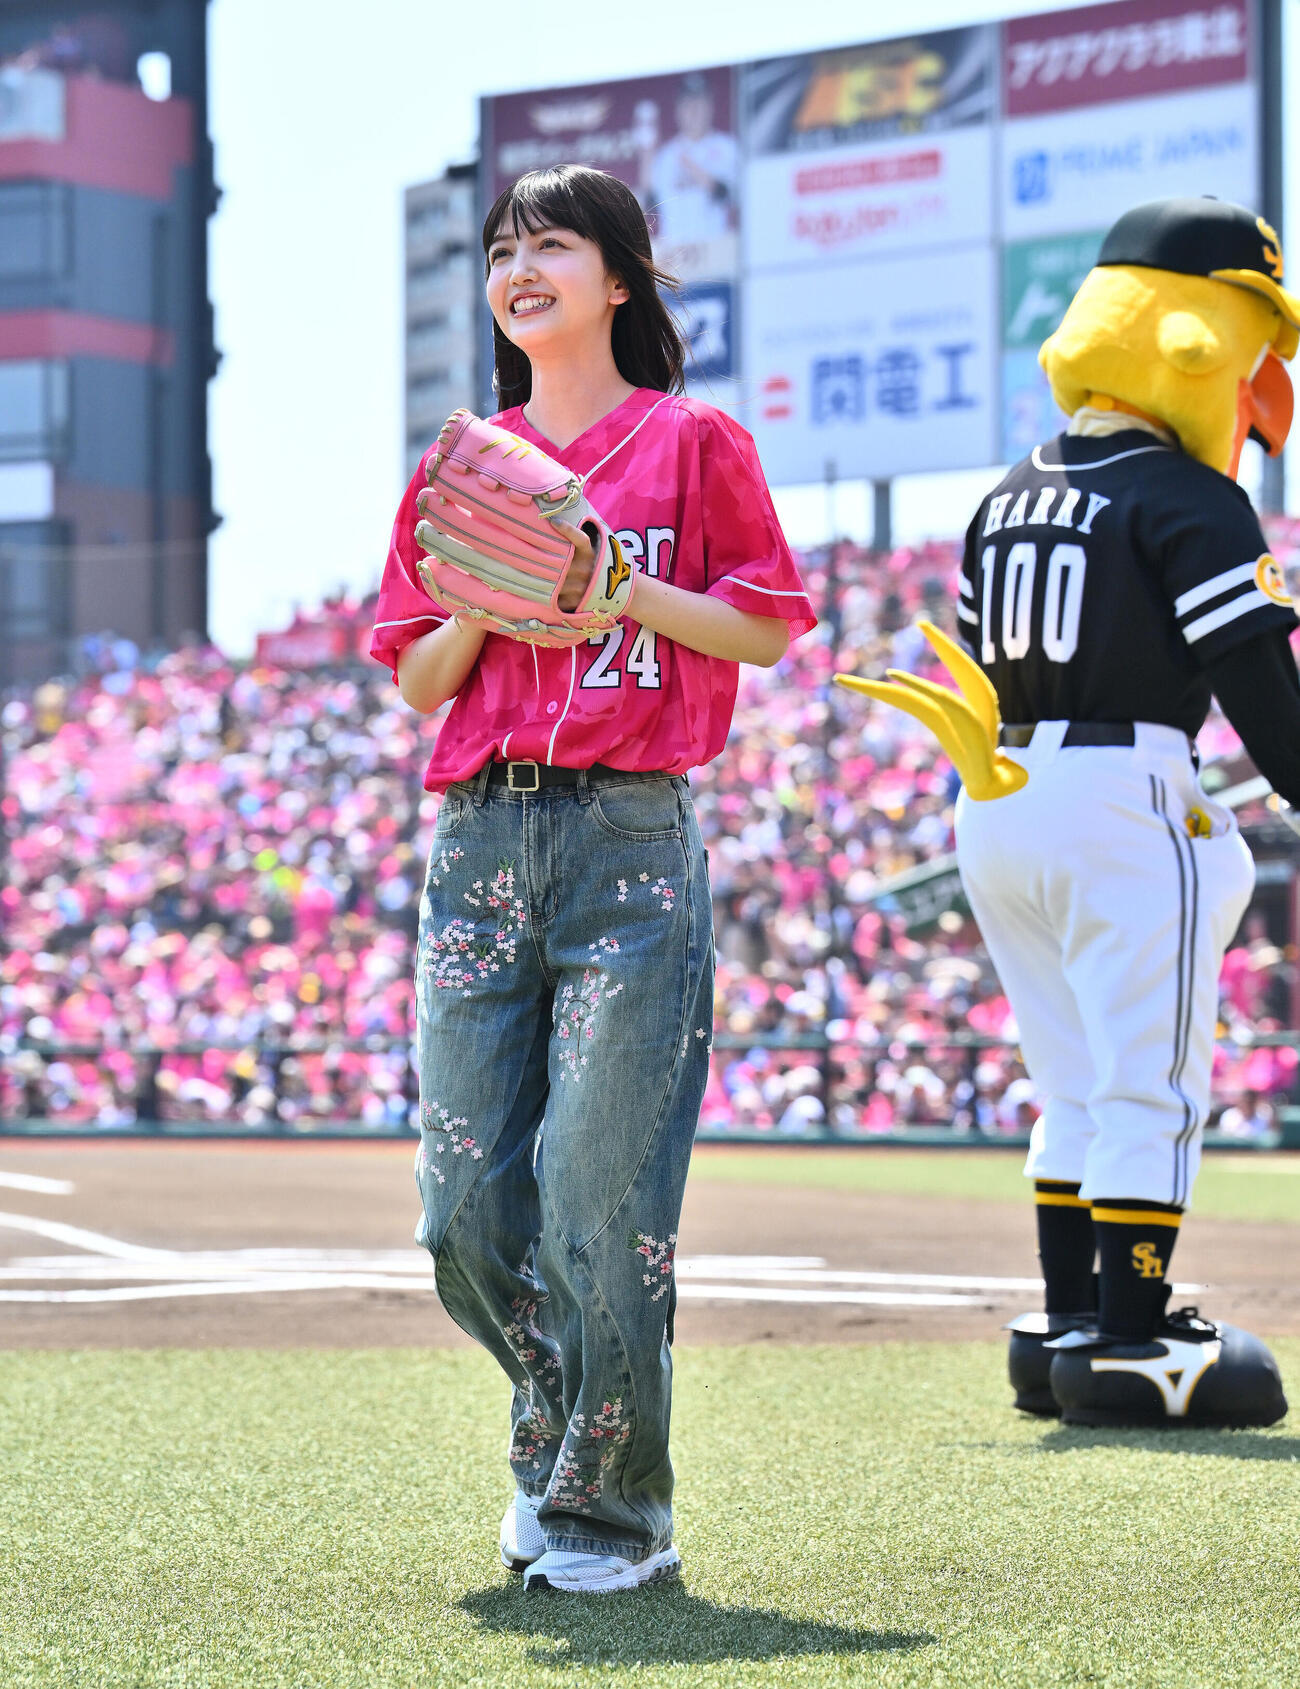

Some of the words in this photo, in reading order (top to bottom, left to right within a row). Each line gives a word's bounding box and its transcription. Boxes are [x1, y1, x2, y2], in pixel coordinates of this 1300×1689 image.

[982, 486, 1112, 537] HARRY
[612, 526, 676, 579] en
[981, 542, 1087, 665] 100
[579, 620, 662, 690] 24
